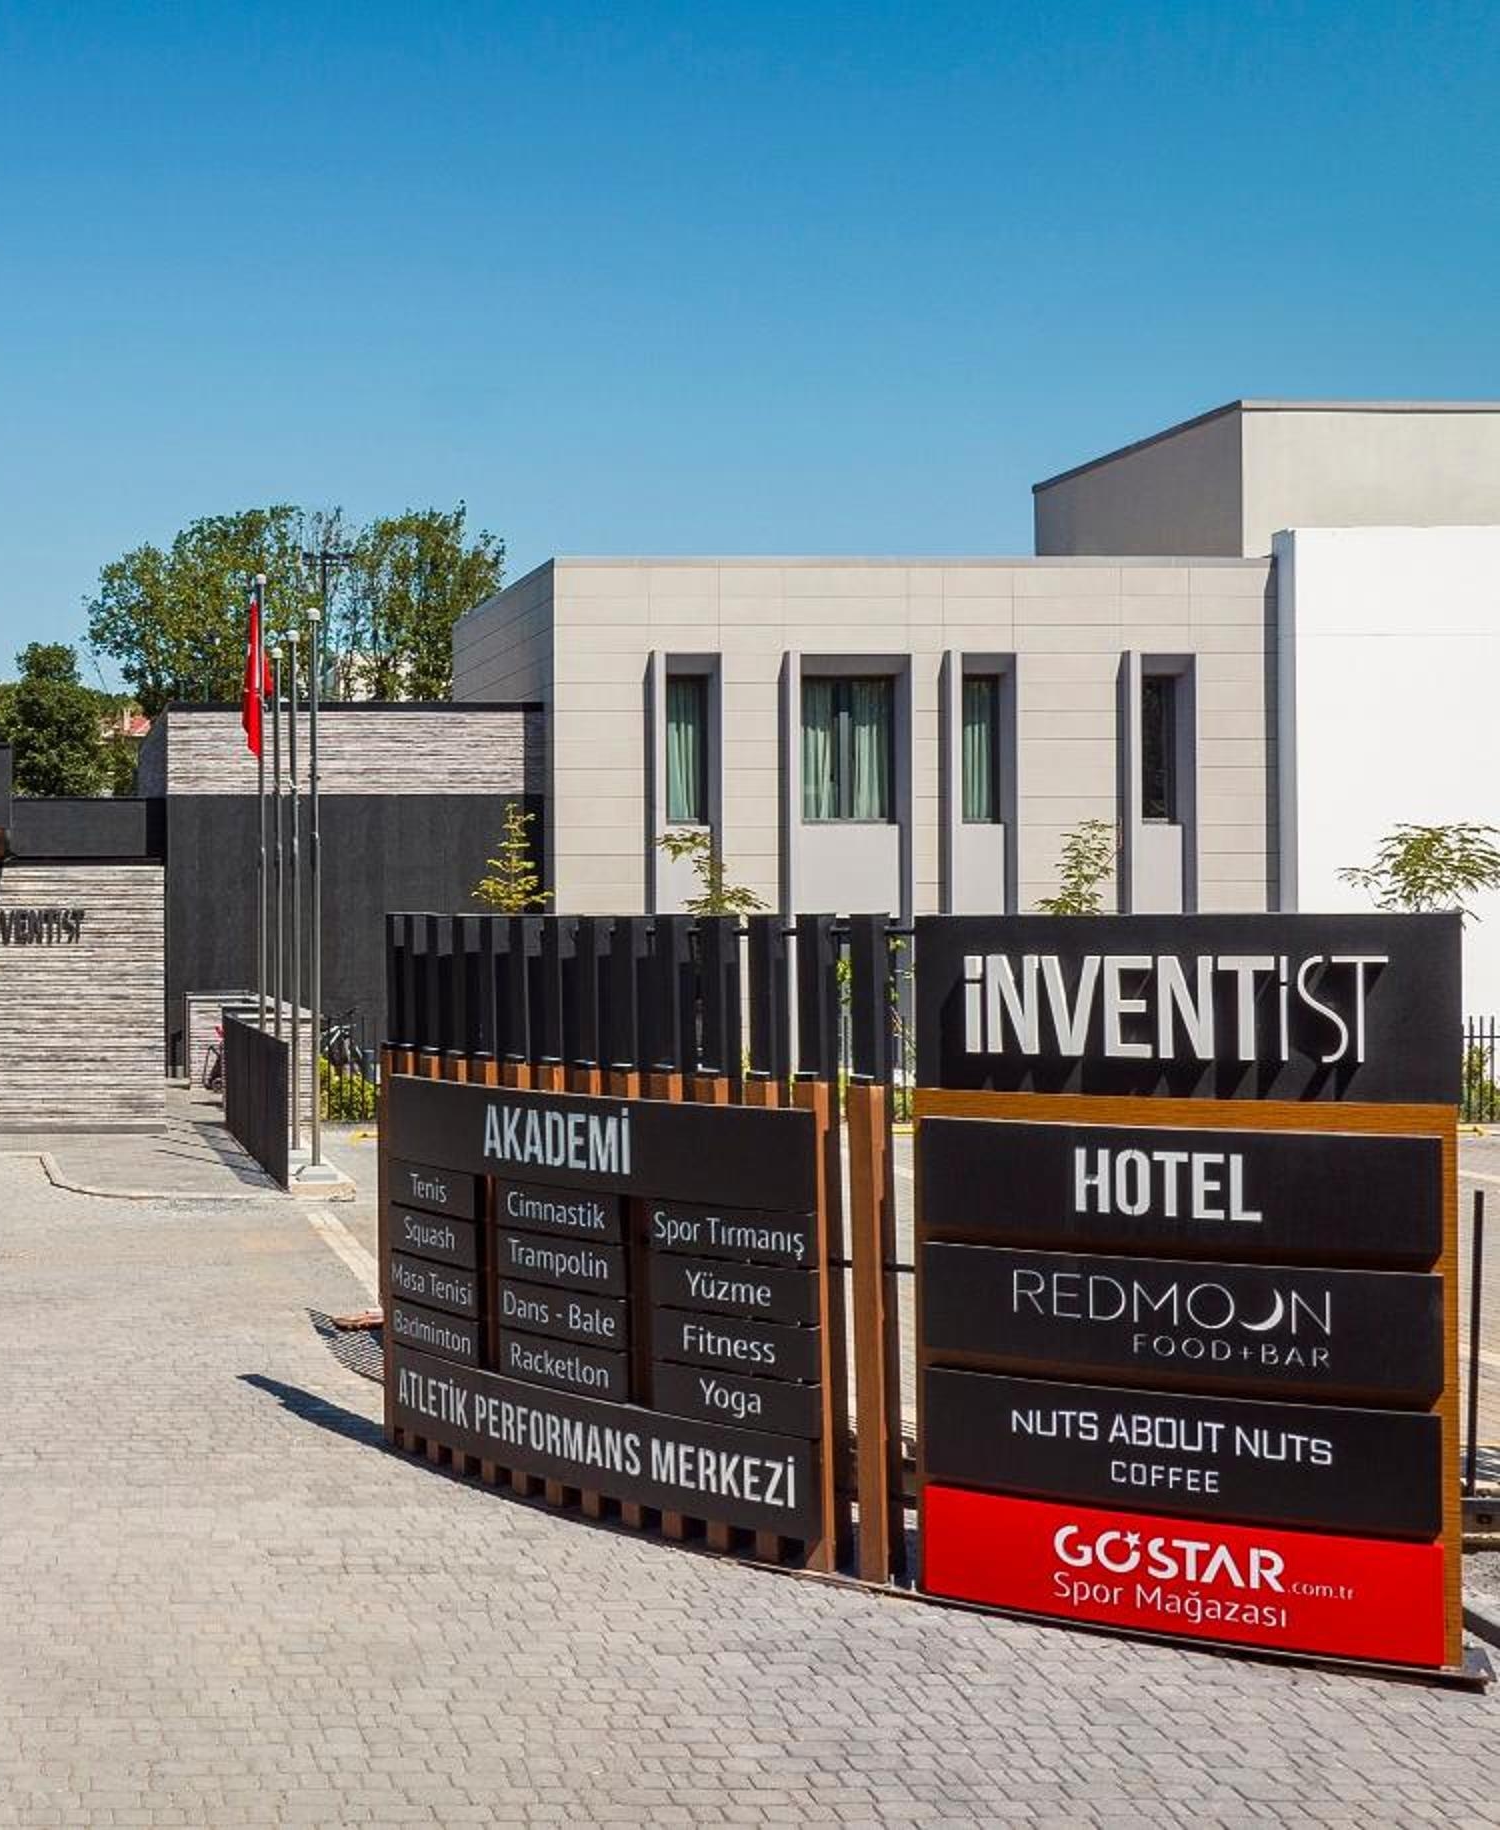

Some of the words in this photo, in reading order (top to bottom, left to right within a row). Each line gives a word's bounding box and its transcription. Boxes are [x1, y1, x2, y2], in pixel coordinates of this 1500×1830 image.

[484, 1104, 632, 1176] AKADEMİ
[410, 1172, 447, 1203] Tenis
[1073, 1148, 1263, 1223] HOTEL
[506, 1191, 605, 1230] Cimnastik
[403, 1216, 455, 1251] Squash
[654, 1211, 700, 1246] Spor
[706, 1217, 805, 1260] Tırmanış
[507, 1236, 609, 1280] Trampolin
[391, 1263, 425, 1293] Masa
[430, 1271, 473, 1307] Tenisi
[685, 1269, 772, 1307] Yüzme
[394, 1309, 472, 1356] Badminton
[503, 1290, 549, 1323] Dans
[568, 1303, 615, 1338] Bale
[509, 1342, 610, 1389] Racketlon
[683, 1324, 776, 1365] Fitness
[1132, 1333, 1332, 1368] FOOD+BAR
[699, 1377, 762, 1420] Yoga
[399, 1367, 470, 1429] ATLETİK
[474, 1393, 641, 1476] PERFORMANS
[650, 1436, 797, 1509] MERKEZİ
[1011, 1409, 1099, 1442] NUTS
[1107, 1413, 1225, 1454] ABOUT
[1234, 1425, 1333, 1466] NUTS
[1110, 1461, 1220, 1494] COFFEE
[1052, 1571, 1125, 1606] Spor
[1135, 1583, 1287, 1629] Mağazası
